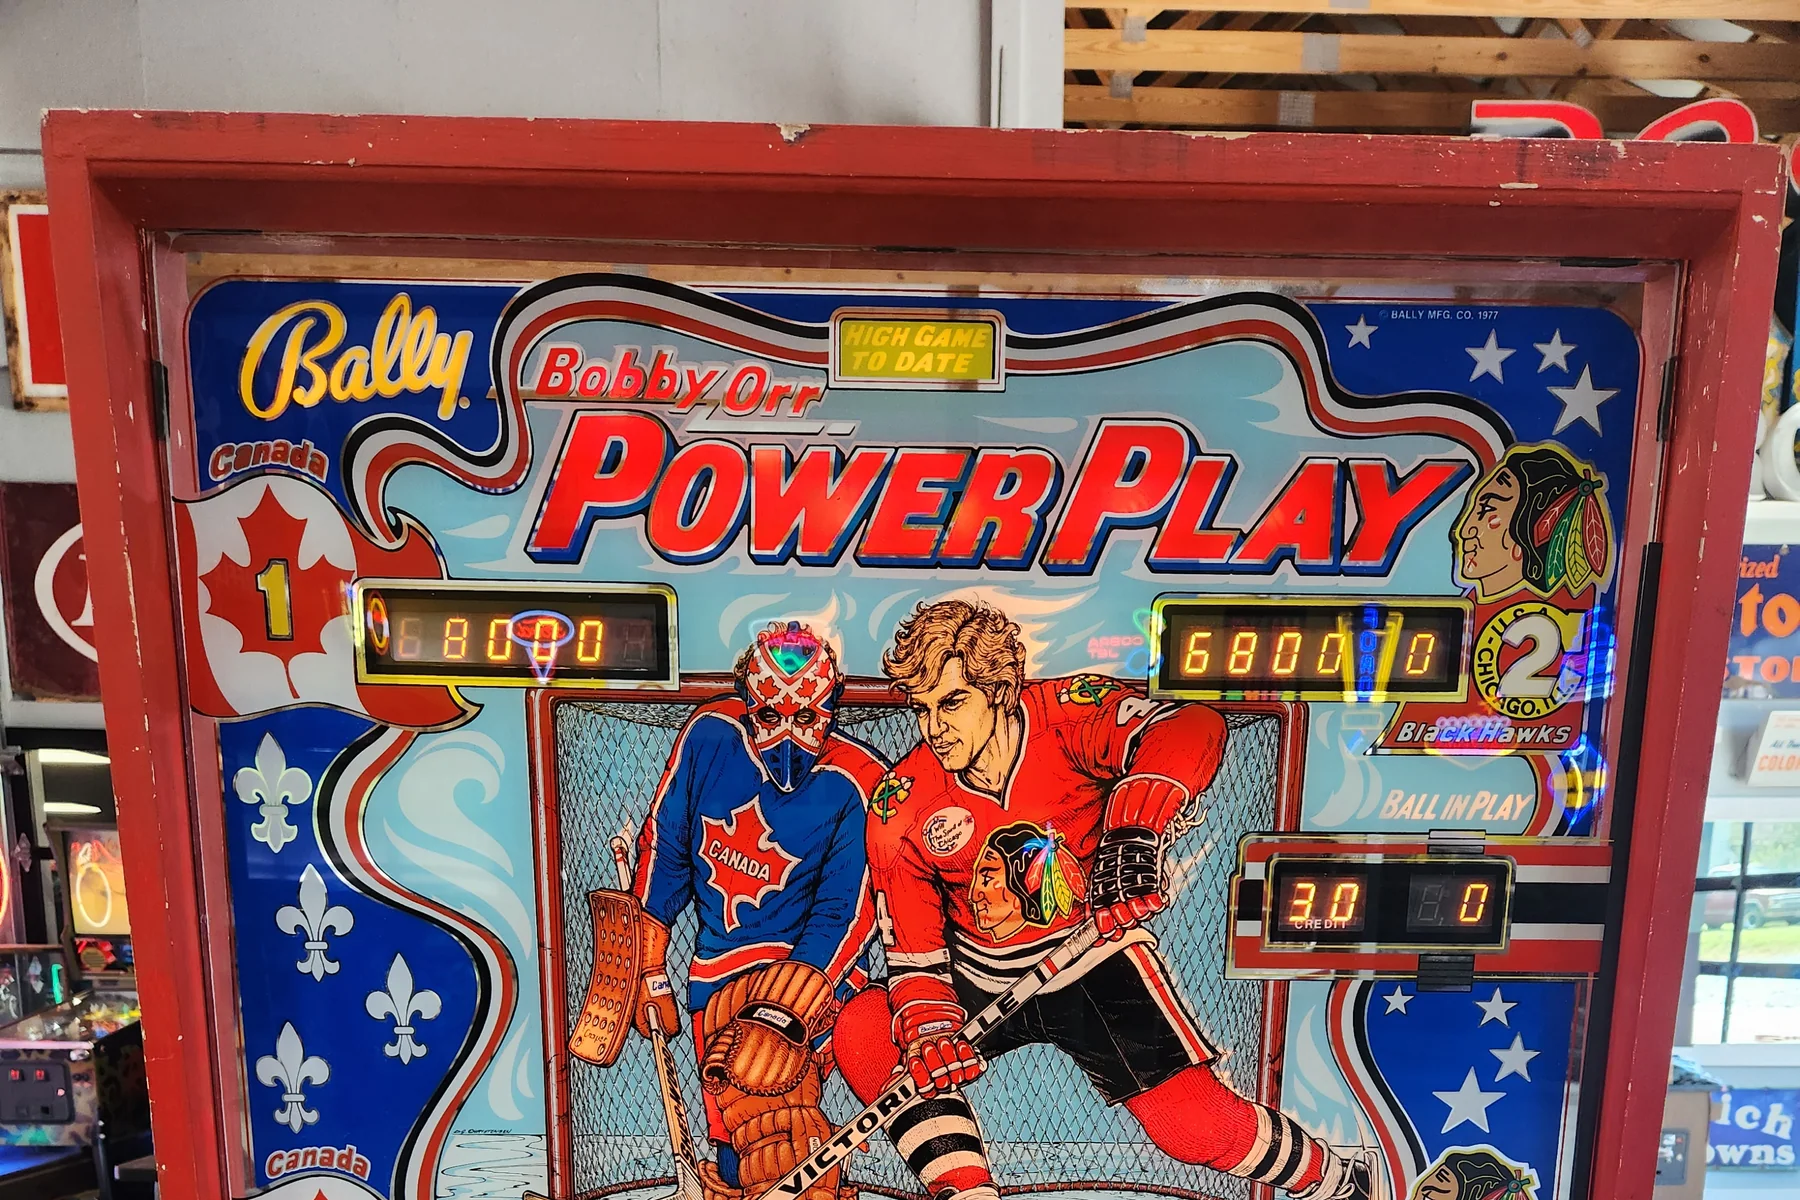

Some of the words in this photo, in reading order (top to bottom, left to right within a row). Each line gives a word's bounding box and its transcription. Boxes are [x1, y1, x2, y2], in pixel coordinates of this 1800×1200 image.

[1391, 310, 1424, 319] BALLY
[1428, 310, 1452, 319] MFG.
[1456, 310, 1473, 319] CO.
[1478, 310, 1499, 319] 1977
[845, 324, 913, 347] HIGH
[914, 324, 988, 349] GAME
[240, 294, 473, 421] Bally
[851, 351, 897, 373] TO
[899, 351, 974, 374] DATE
[537, 343, 720, 411] Bobby
[722, 370, 828, 418] Orr
[206, 438, 330, 483] Canada
[256, 557, 294, 640] 1
[1500, 612, 1558, 699] 2
[1725, 655, 1800, 684] TO
[1477, 647, 1542, 716] CHICGO,
[707, 838, 771, 883] CANADA
[1288, 882, 1360, 922] 30
[1459, 883, 1489, 923] 0
[1294, 918, 1347, 930] CREDIT
[266, 1145, 371, 1180] Canada
